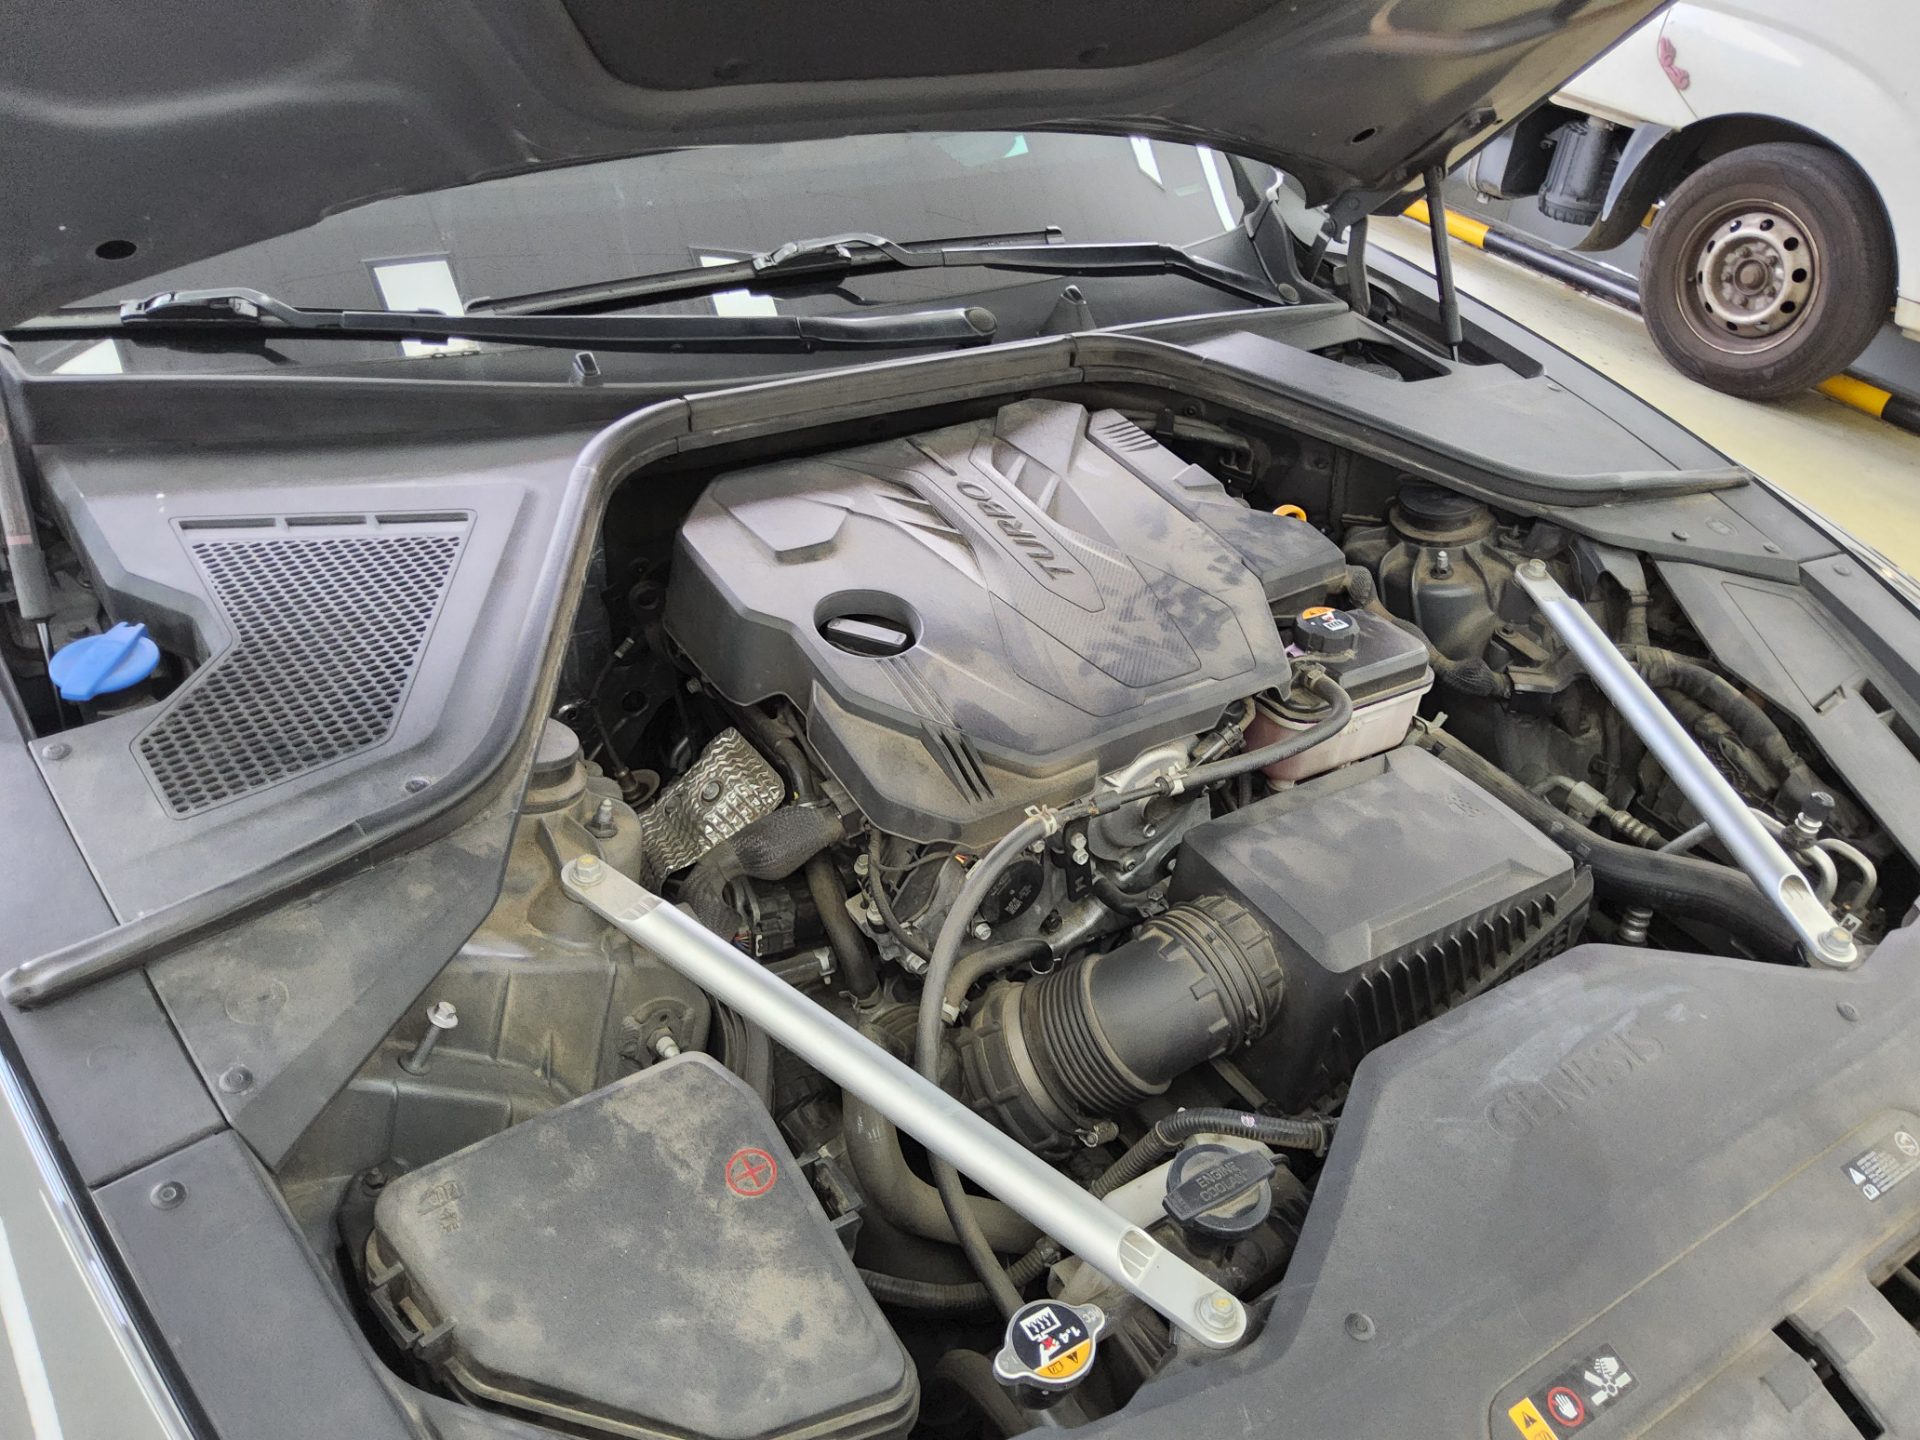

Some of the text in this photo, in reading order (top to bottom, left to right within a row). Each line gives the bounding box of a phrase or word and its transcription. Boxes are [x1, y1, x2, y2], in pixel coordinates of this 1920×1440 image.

[956, 480, 1075, 580] TURBO
[1484, 1030, 1665, 1141] GENESIS
[1195, 1160, 1239, 1189] ENGINE
[1199, 1168, 1249, 1202] COOLANT
[1058, 1325, 1081, 1344] 1.4
